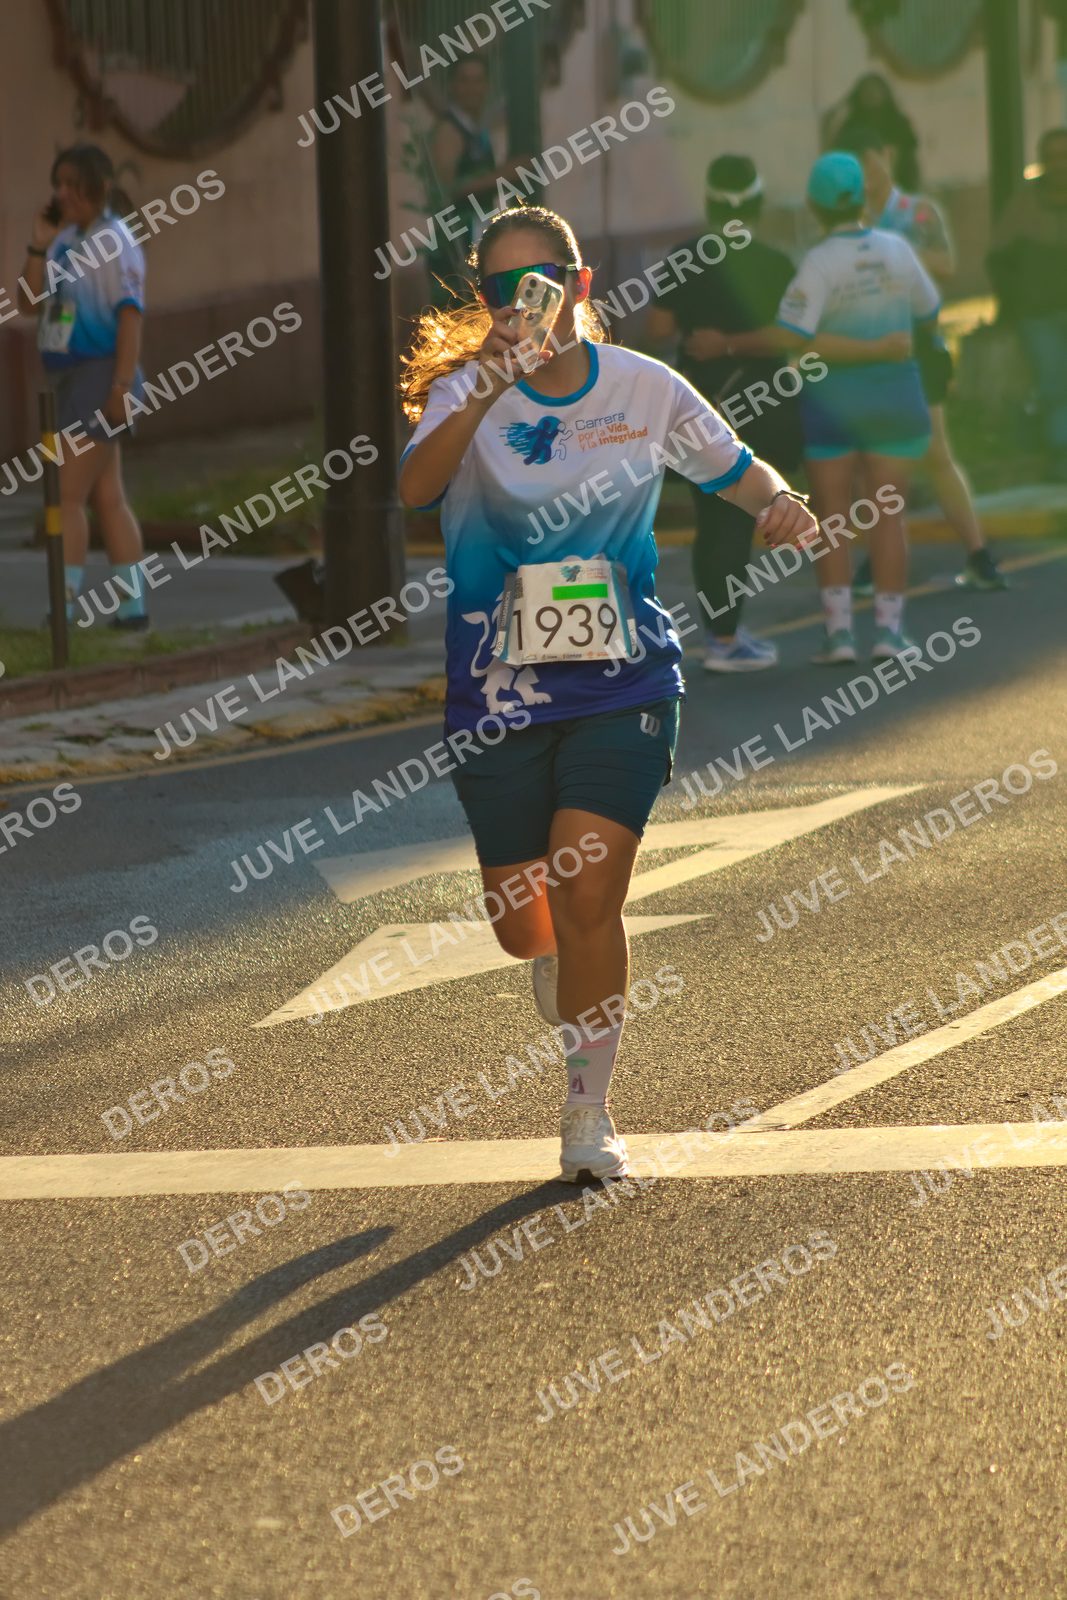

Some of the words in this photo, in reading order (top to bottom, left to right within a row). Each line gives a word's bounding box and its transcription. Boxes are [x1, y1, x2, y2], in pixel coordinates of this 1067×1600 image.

[575, 411, 625, 431] Carrera
[577, 431, 594, 443] por
[596, 428, 606, 438] la
[606, 422, 629, 434] Vida
[579, 443, 586, 453] y
[588, 440, 597, 450] la
[599, 425, 648, 445] Integridad
[512, 603, 618, 651] 1939
